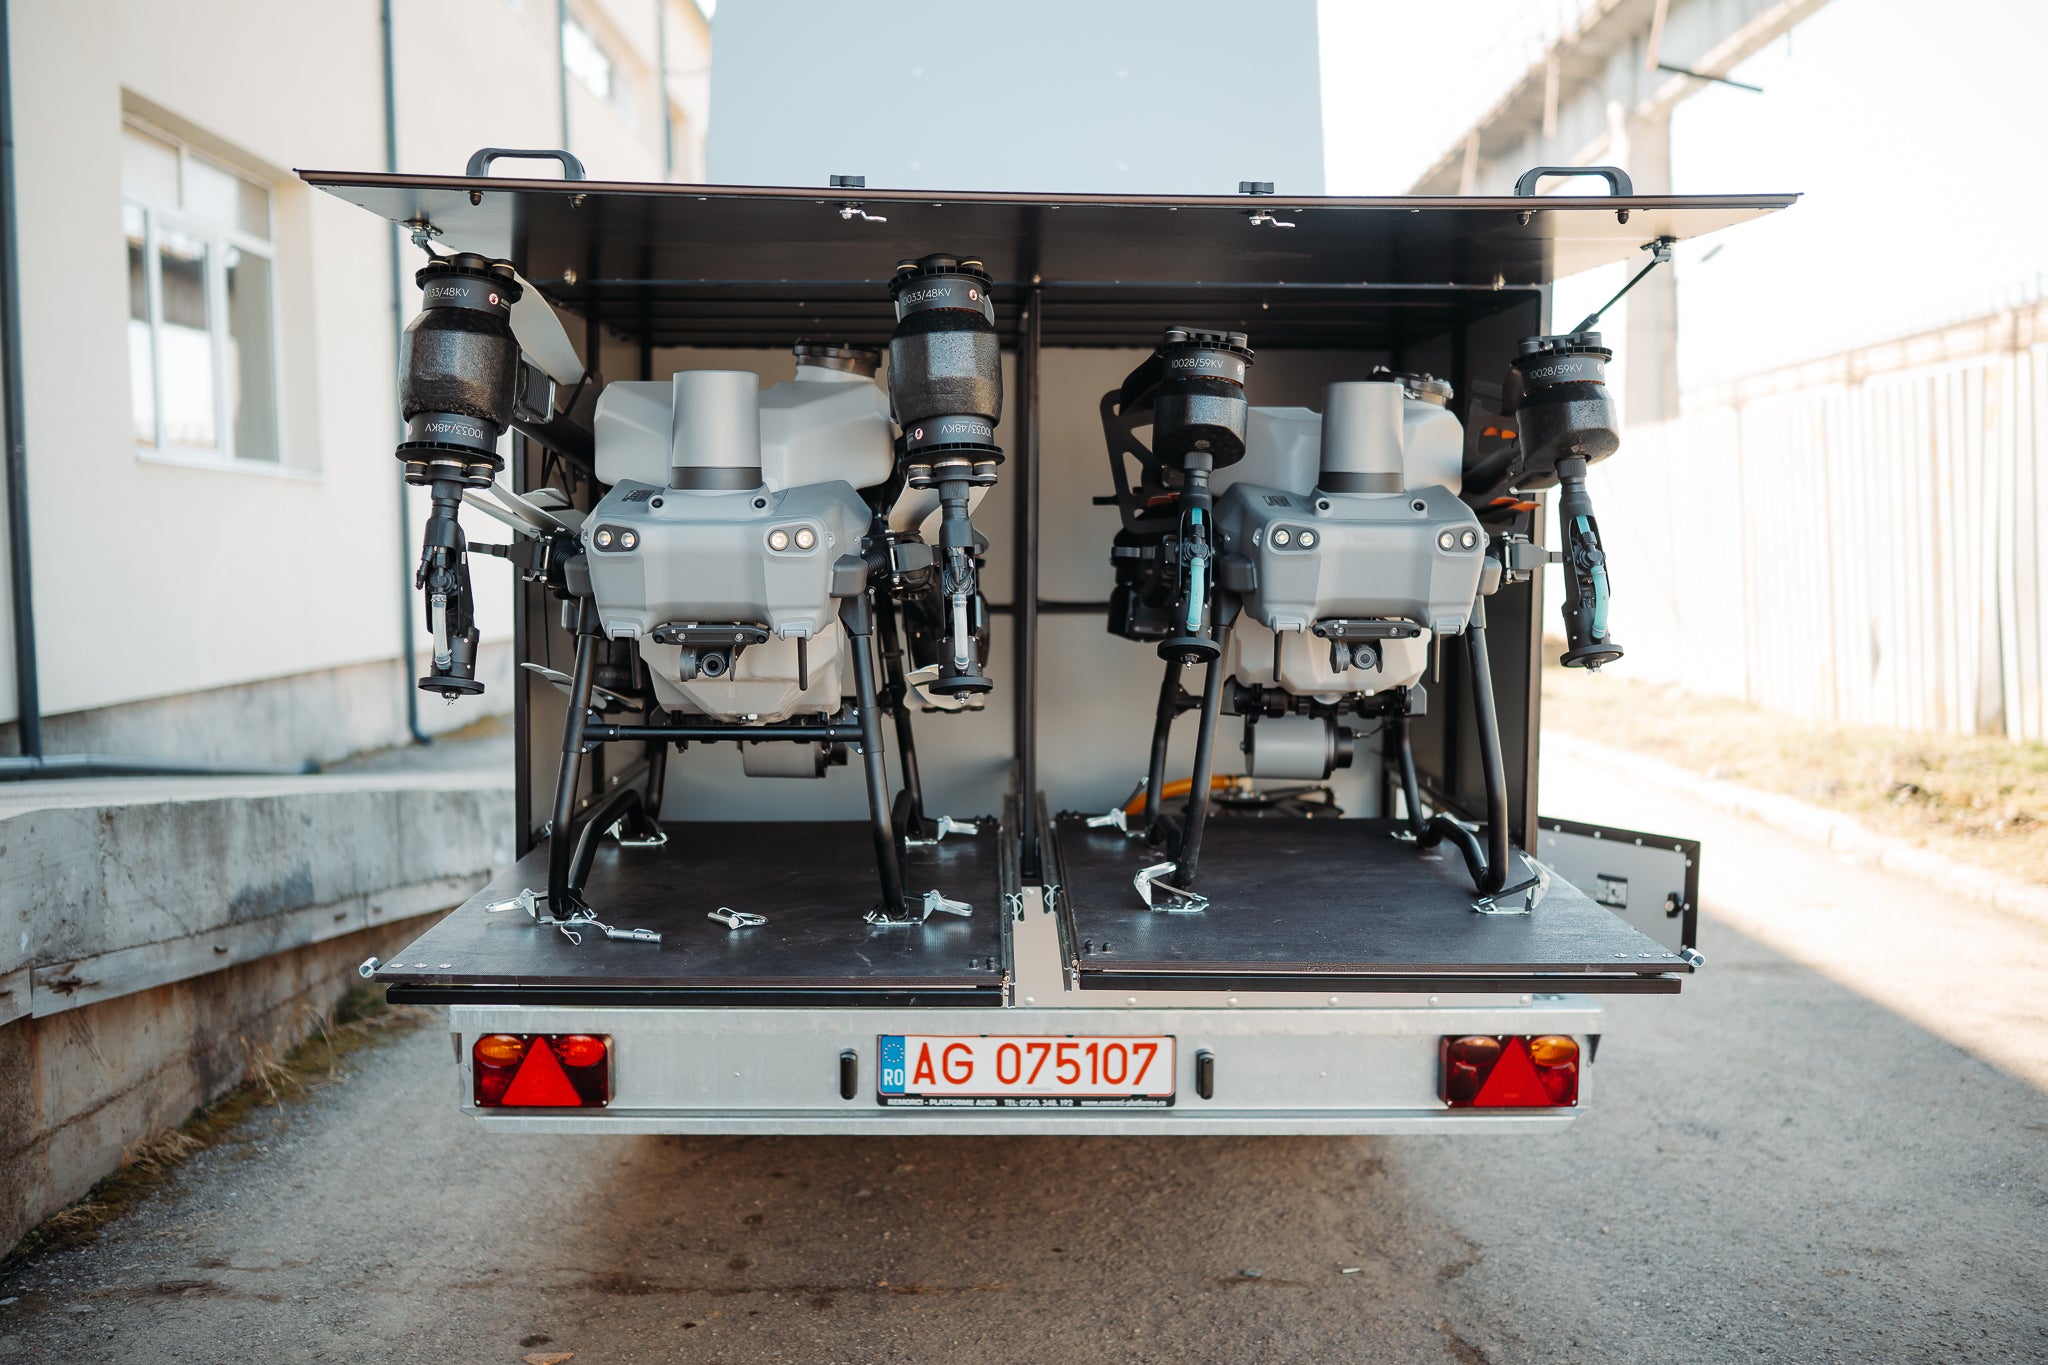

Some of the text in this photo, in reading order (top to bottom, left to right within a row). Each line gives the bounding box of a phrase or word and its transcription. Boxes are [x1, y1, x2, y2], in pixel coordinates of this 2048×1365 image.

[1171, 358, 1224, 369] 10028/59KV
[425, 423, 484, 440] 10033/48KV
[912, 1042, 1158, 1086] AG 075107
[883, 1068, 904, 1086] RO
[887, 1098, 924, 1106] REMORCI
[929, 1098, 975, 1106] PLATFORME
[976, 1098, 997, 1106] AUTO
